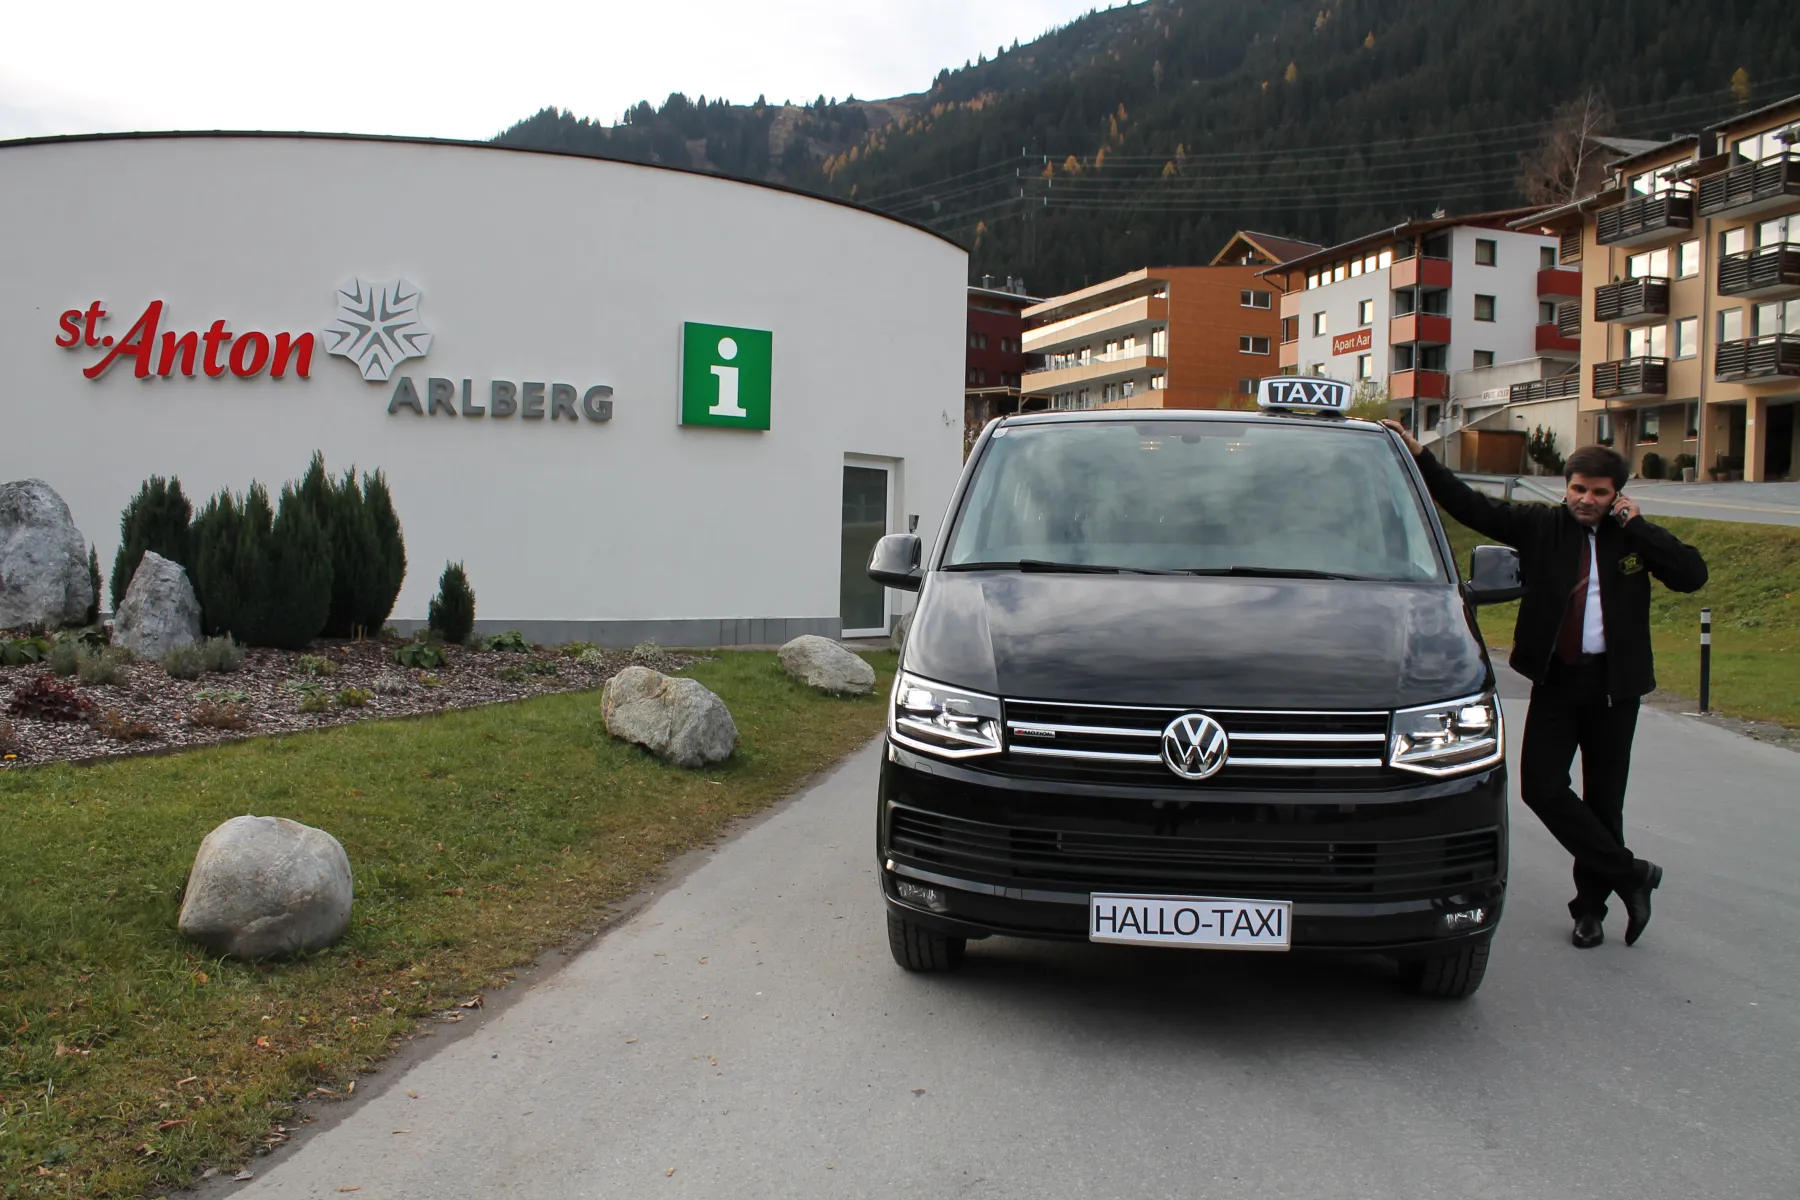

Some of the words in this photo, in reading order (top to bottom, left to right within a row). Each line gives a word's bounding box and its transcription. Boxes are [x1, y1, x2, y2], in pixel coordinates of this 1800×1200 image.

[83, 299, 316, 379] Anton
[1333, 337, 1355, 353] Apart
[1356, 334, 1371, 348] Aar
[387, 376, 614, 422] ARLBERG
[1272, 382, 1338, 406] TAXI
[1095, 904, 1283, 937] HALLO-TAXI
